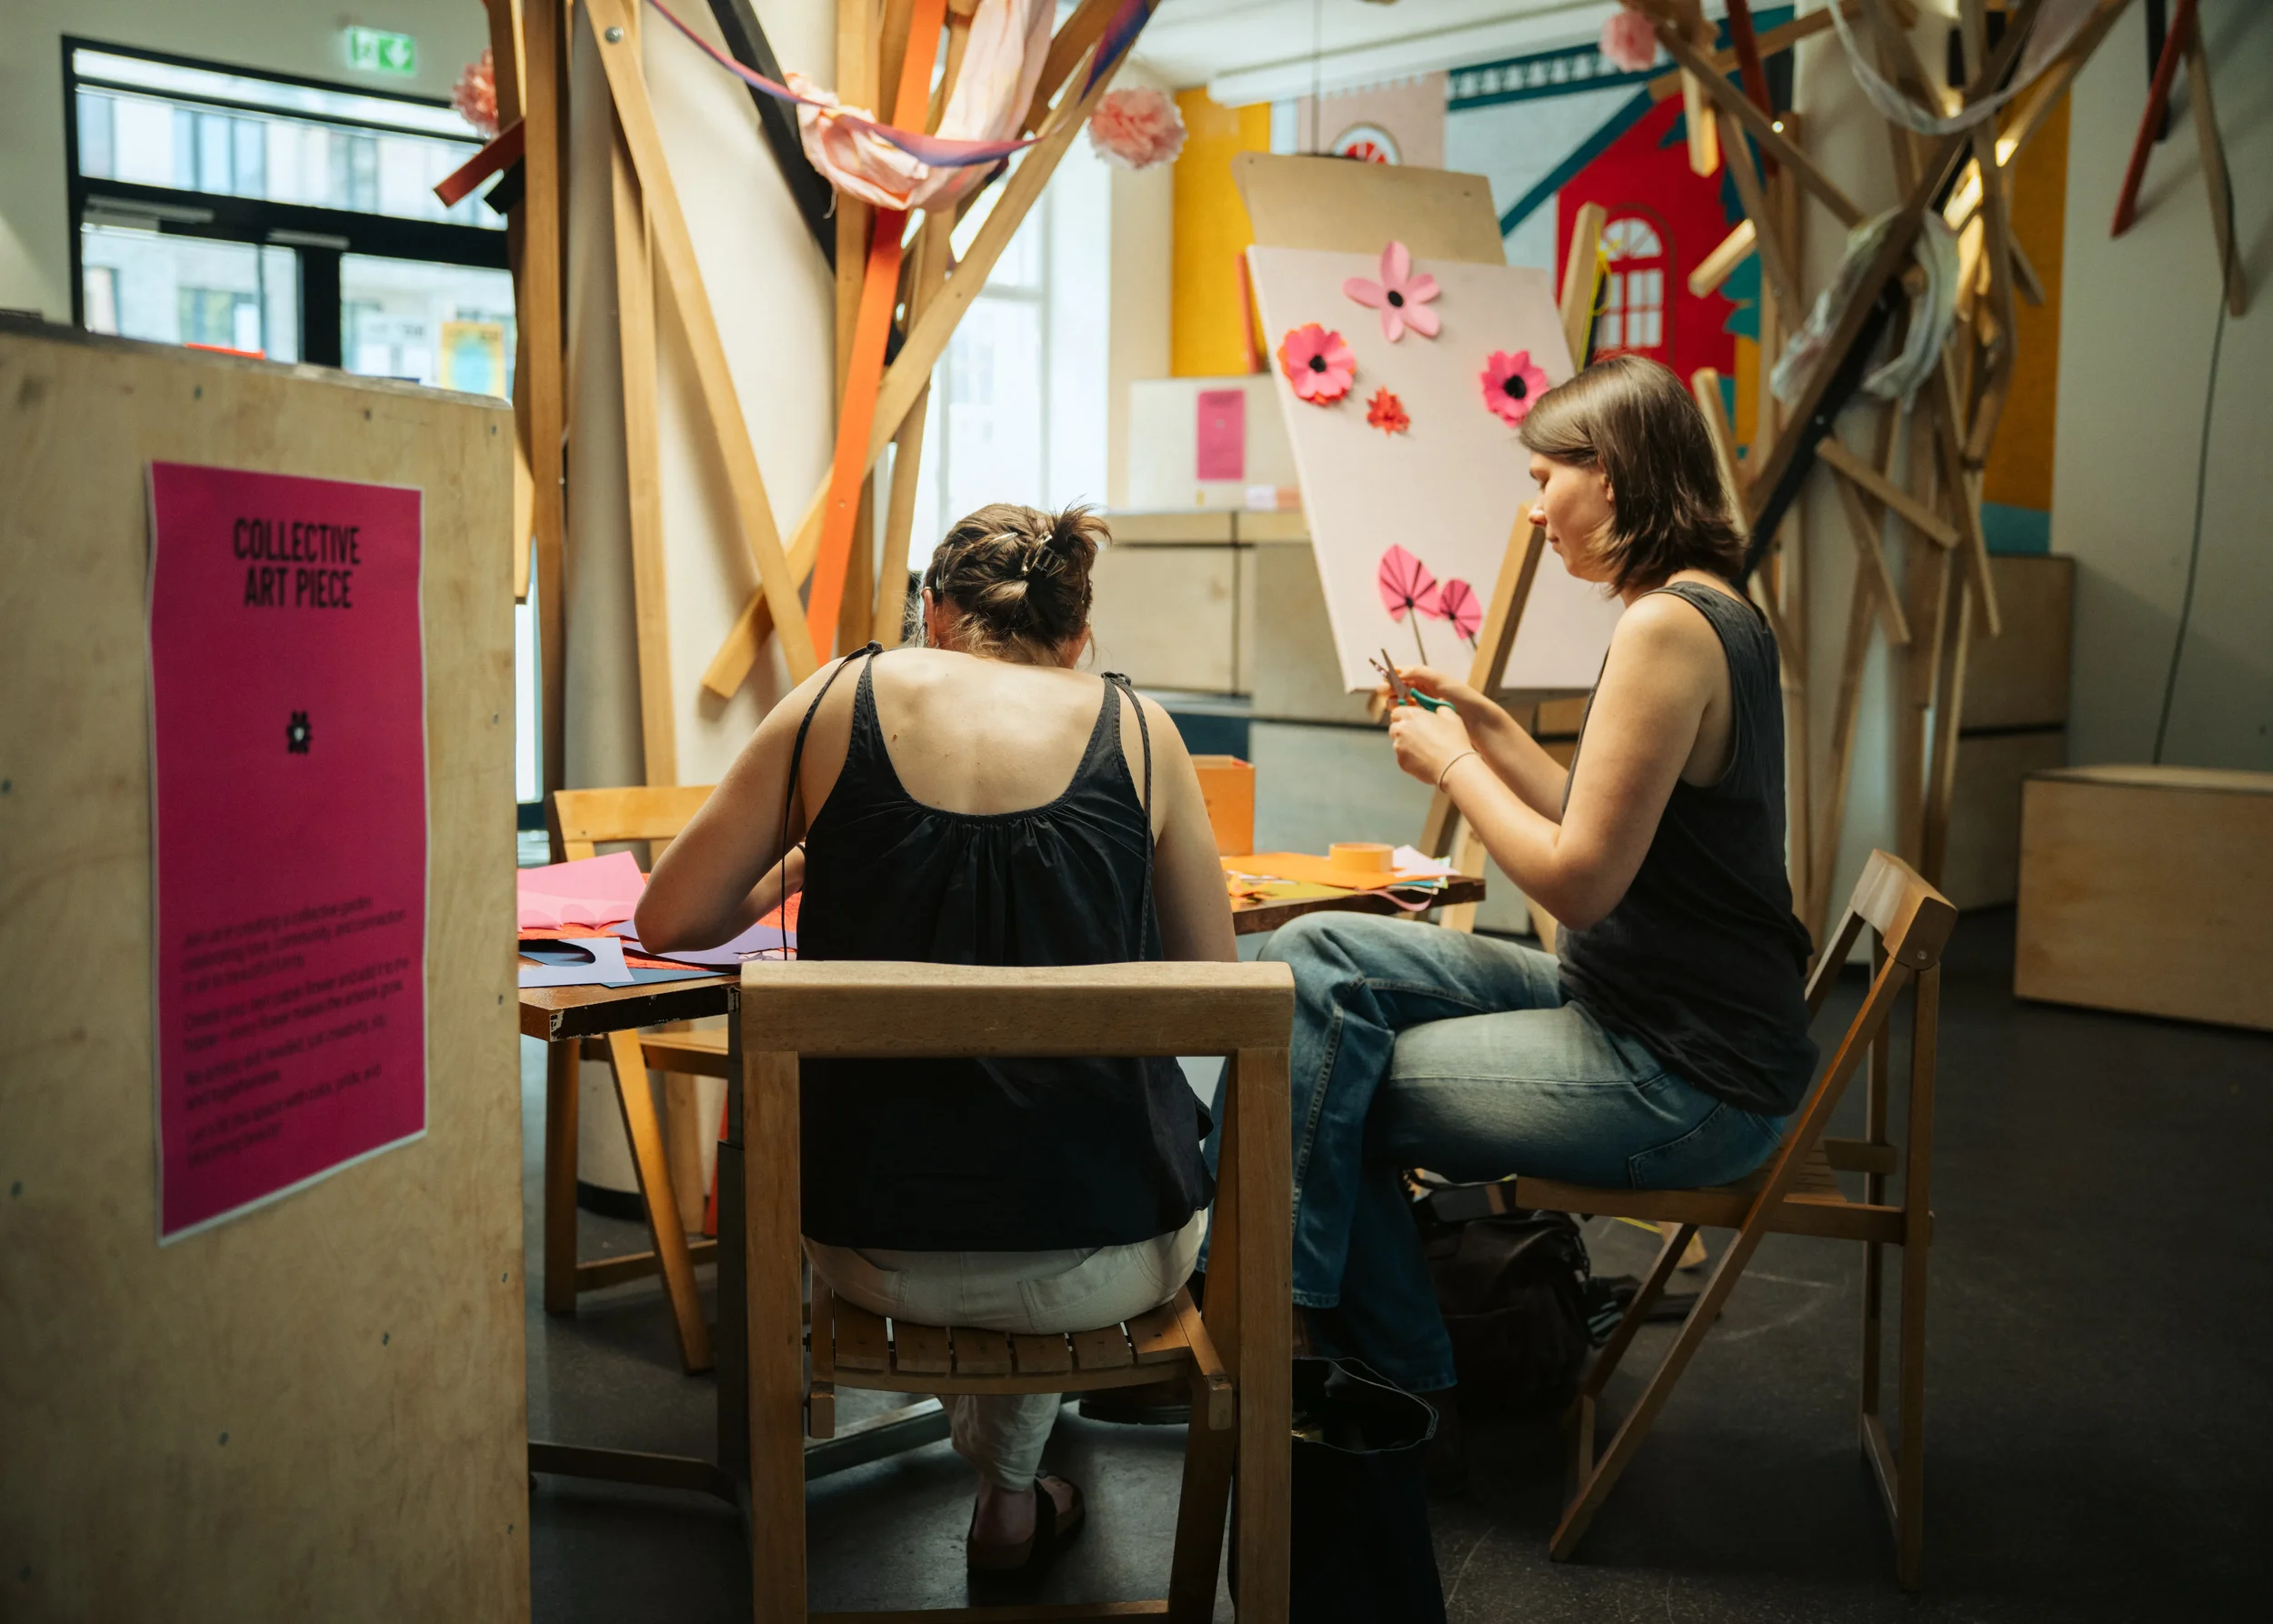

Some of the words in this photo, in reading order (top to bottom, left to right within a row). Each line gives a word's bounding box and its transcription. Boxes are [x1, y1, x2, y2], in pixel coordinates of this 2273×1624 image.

[234, 517, 361, 565] COLLECTIVE
[244, 566, 288, 607] ART
[296, 566, 353, 608] PIECE
